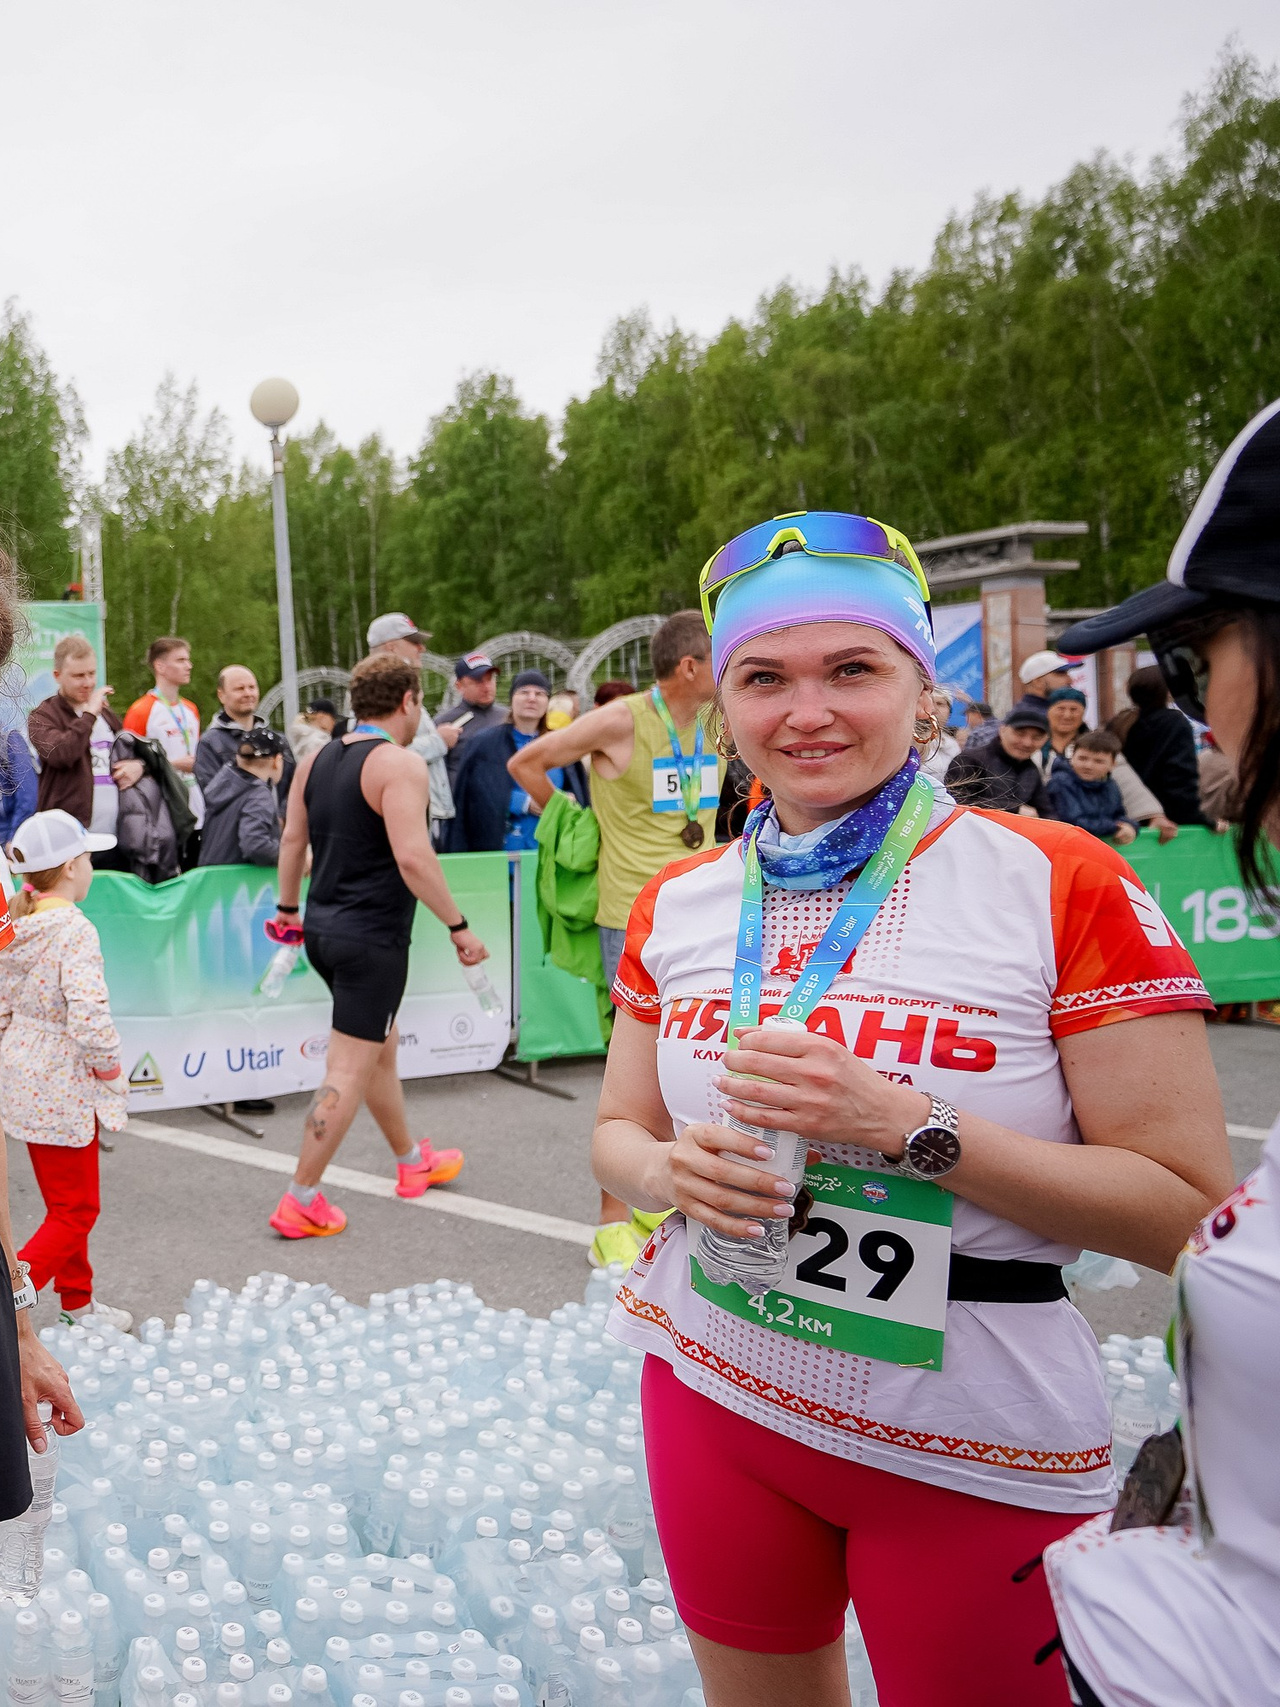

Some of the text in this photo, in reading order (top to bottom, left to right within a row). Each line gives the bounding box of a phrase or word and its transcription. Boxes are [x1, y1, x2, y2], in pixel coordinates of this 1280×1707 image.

[913, 798, 924, 818] лет
[899, 818, 915, 838] 185
[745, 926, 755, 948] Utair
[837, 915, 858, 939] Utair
[797, 973, 820, 1003] СБЕР
[740, 988, 751, 1018] СБЕР
[887, 997, 941, 1011] ОКРУГ
[952, 1003, 998, 1019] ЮГРА
[226, 1044, 285, 1073] Utair
[692, 1048, 723, 1063] КЛУ
[747, 1294, 796, 1326] 4,2
